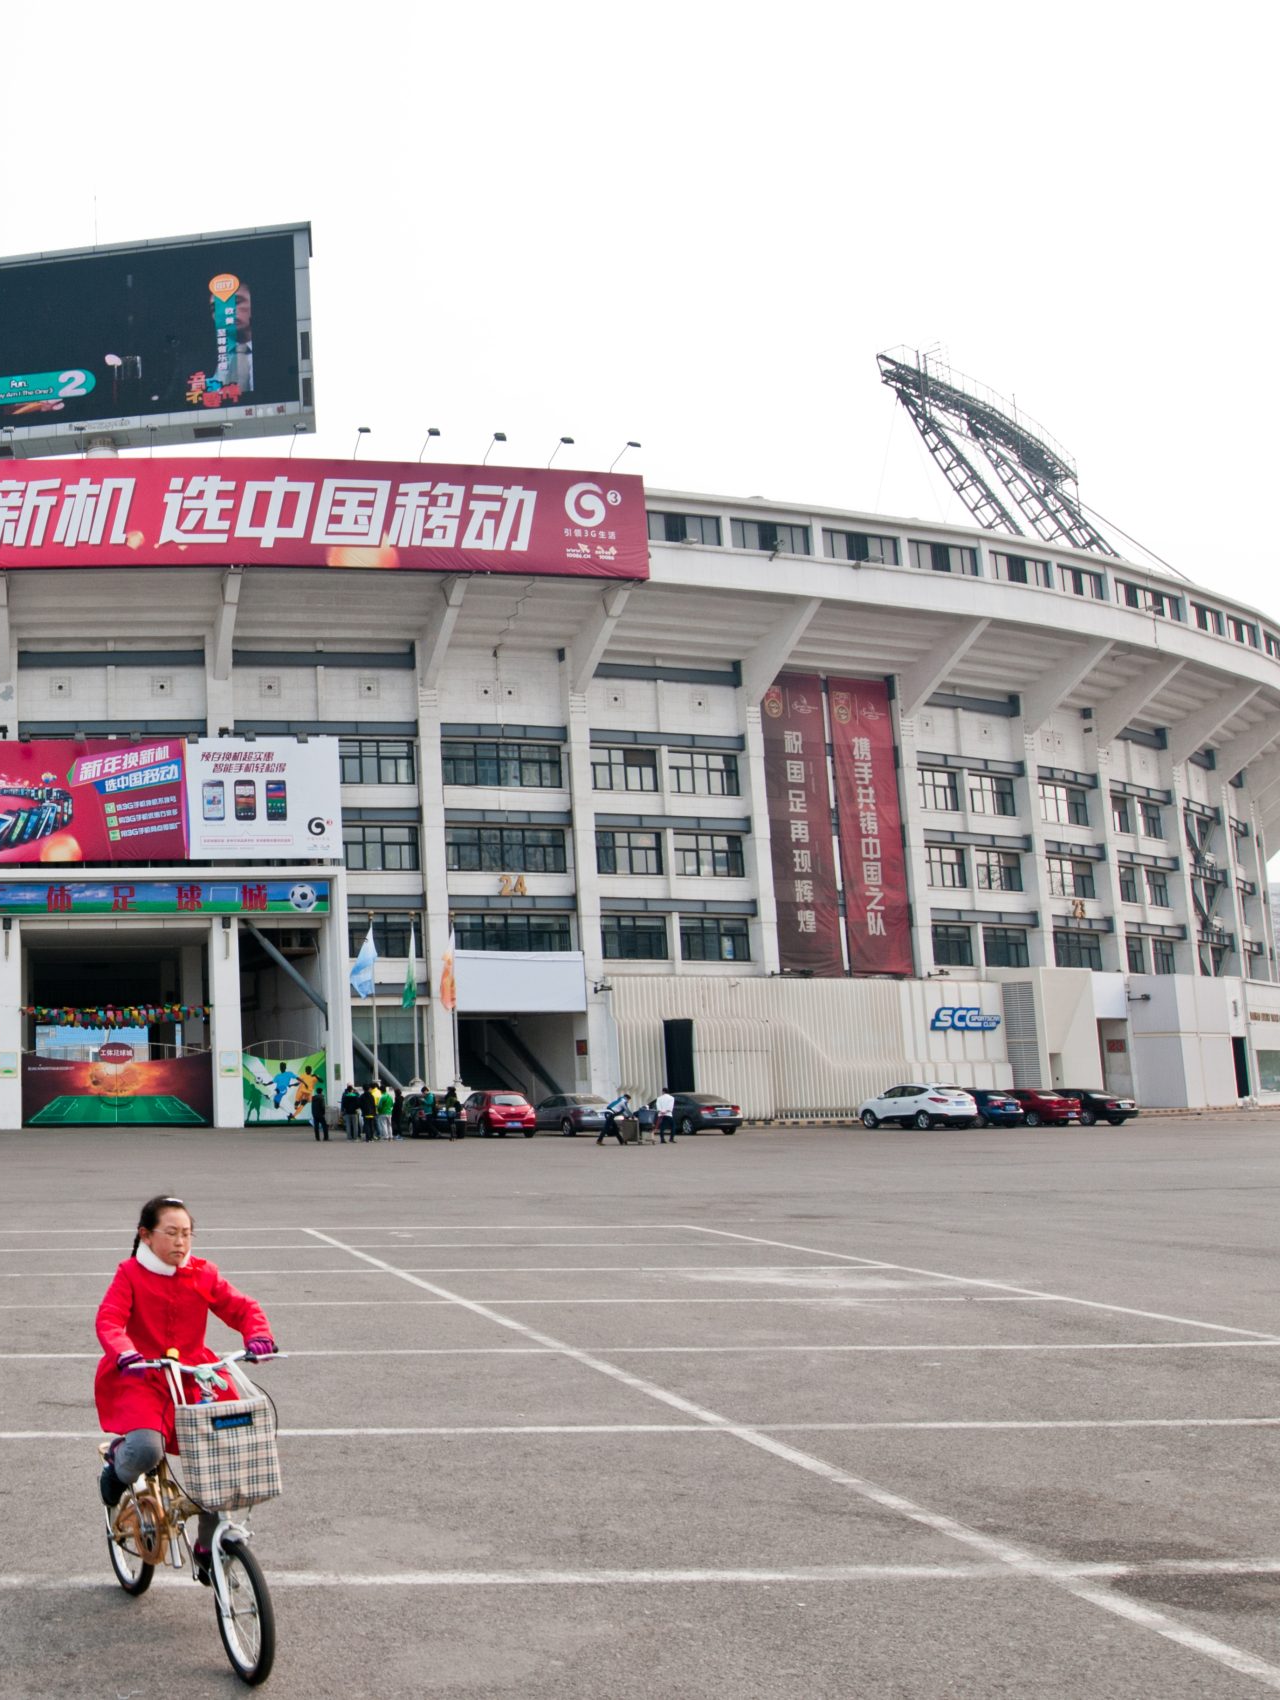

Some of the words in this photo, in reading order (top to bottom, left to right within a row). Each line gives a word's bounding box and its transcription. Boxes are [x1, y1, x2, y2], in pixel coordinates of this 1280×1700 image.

[58, 370, 87, 398] 2
[161, 475, 538, 552] 选中国移动
[79, 745, 170, 782] 新年换新机
[200, 751, 275, 762] 预存换机超实惠
[212, 762, 287, 774] 智能手机轻松得
[105, 764, 179, 792] 选中国移动
[784, 731, 816, 933] 祝国足再现辉煌
[852, 737, 886, 936] 携手共铸中国之队
[499, 875, 527, 896] 24
[935, 1009, 982, 1027] SCC
